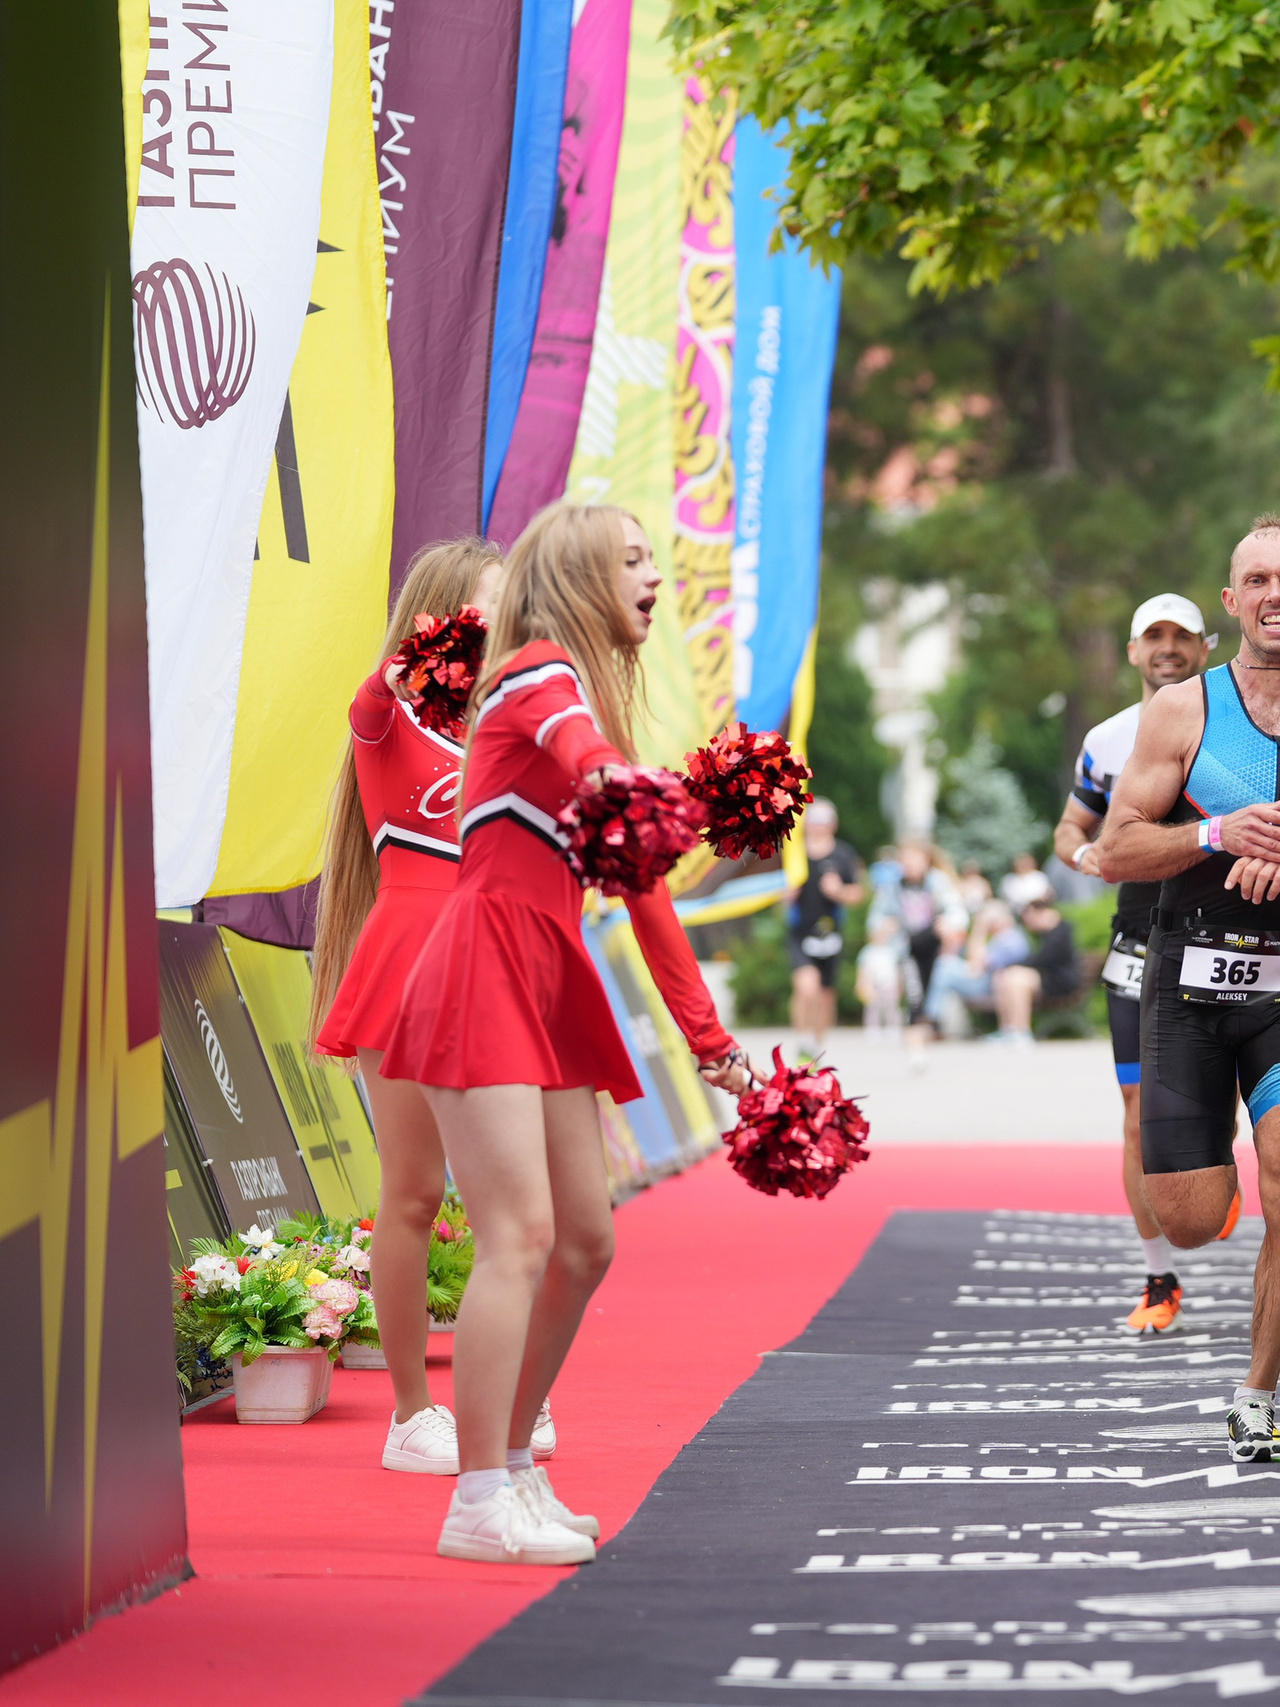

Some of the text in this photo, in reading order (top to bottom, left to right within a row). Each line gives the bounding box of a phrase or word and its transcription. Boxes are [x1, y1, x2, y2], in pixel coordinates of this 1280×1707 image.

[136, 0, 175, 207] ГАЗ
[756, 305, 783, 375] ДОМ
[1224, 932, 1239, 941] IRON
[1244, 935, 1260, 944] STAR
[1210, 957, 1261, 985] 365
[1216, 992, 1248, 1001] ALEKSEY
[890, 1398, 1142, 1412] IRON
[856, 1466, 1145, 1479] IRON
[806, 1551, 1141, 1568] IRON
[728, 1656, 1134, 1680] IRON
